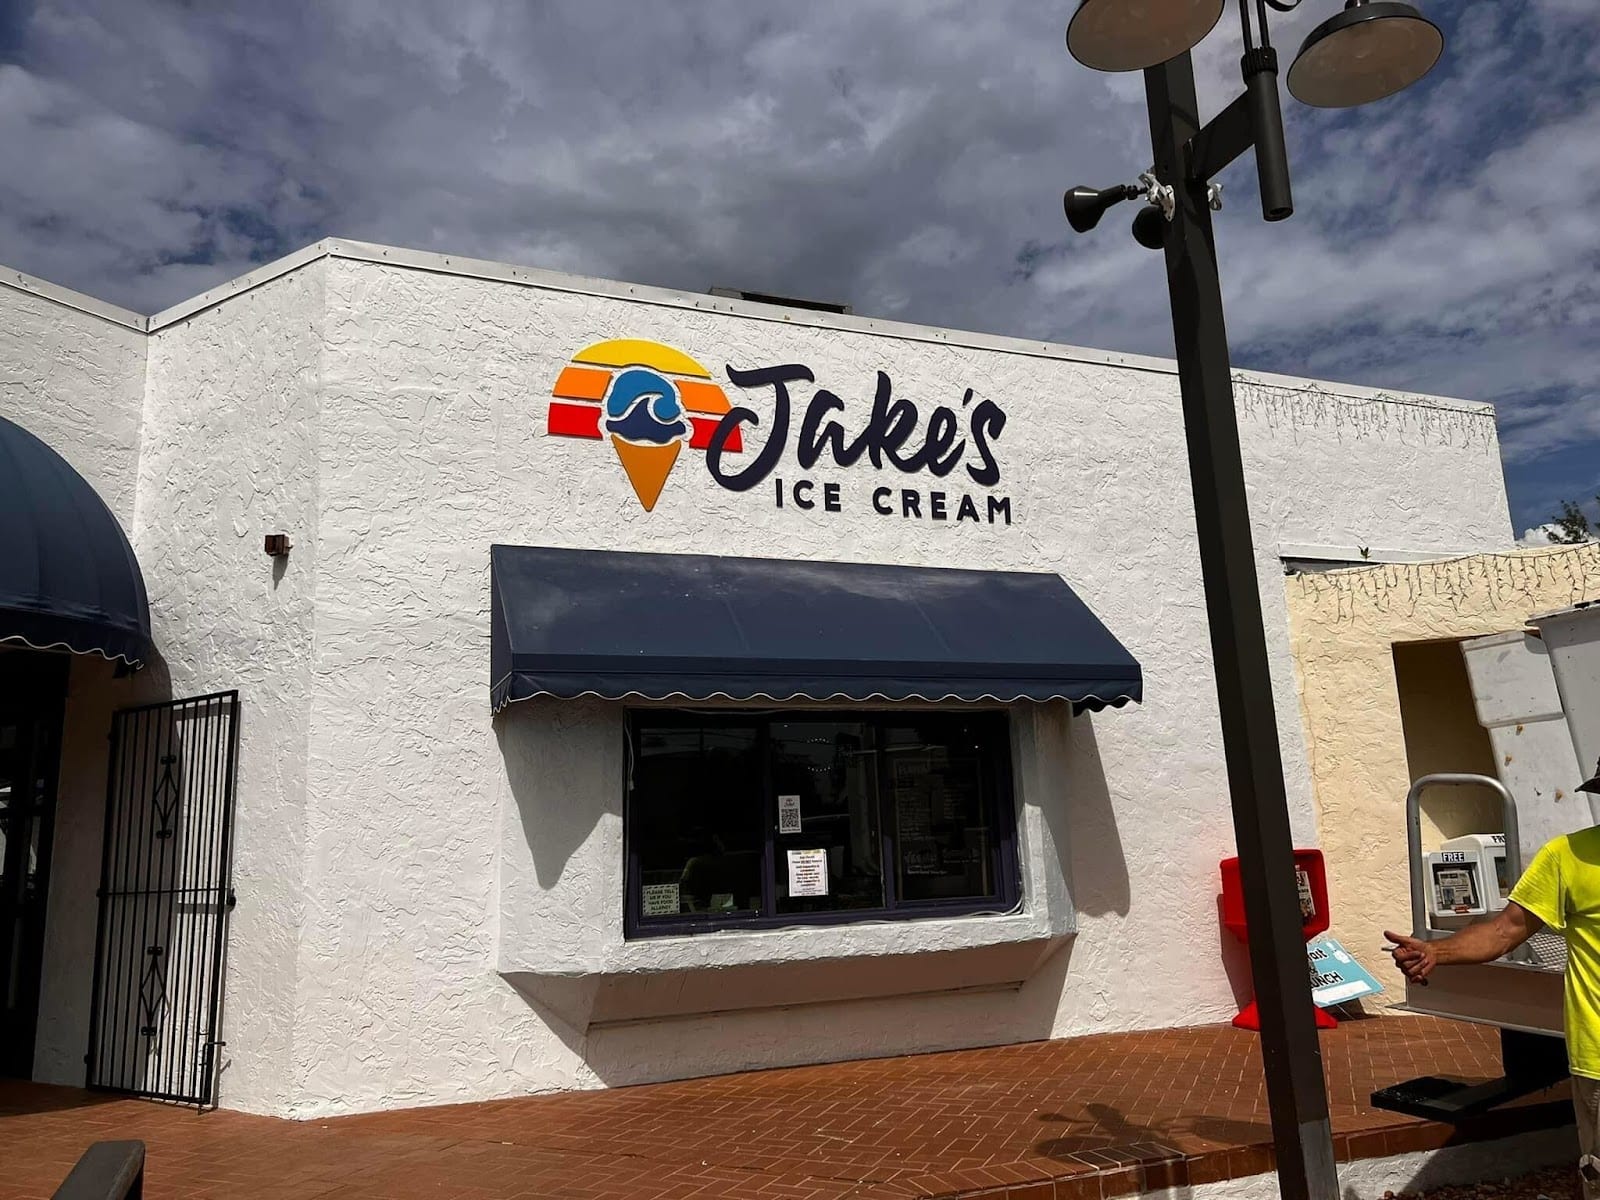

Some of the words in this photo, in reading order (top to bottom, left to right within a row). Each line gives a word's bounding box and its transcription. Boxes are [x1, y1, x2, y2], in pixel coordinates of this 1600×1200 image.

[706, 364, 1007, 491] Jake's
[776, 479, 841, 512] ICE
[872, 486, 1012, 525] CREAM
[1443, 852, 1464, 862] FREE
[1311, 972, 1343, 989] UNCH
